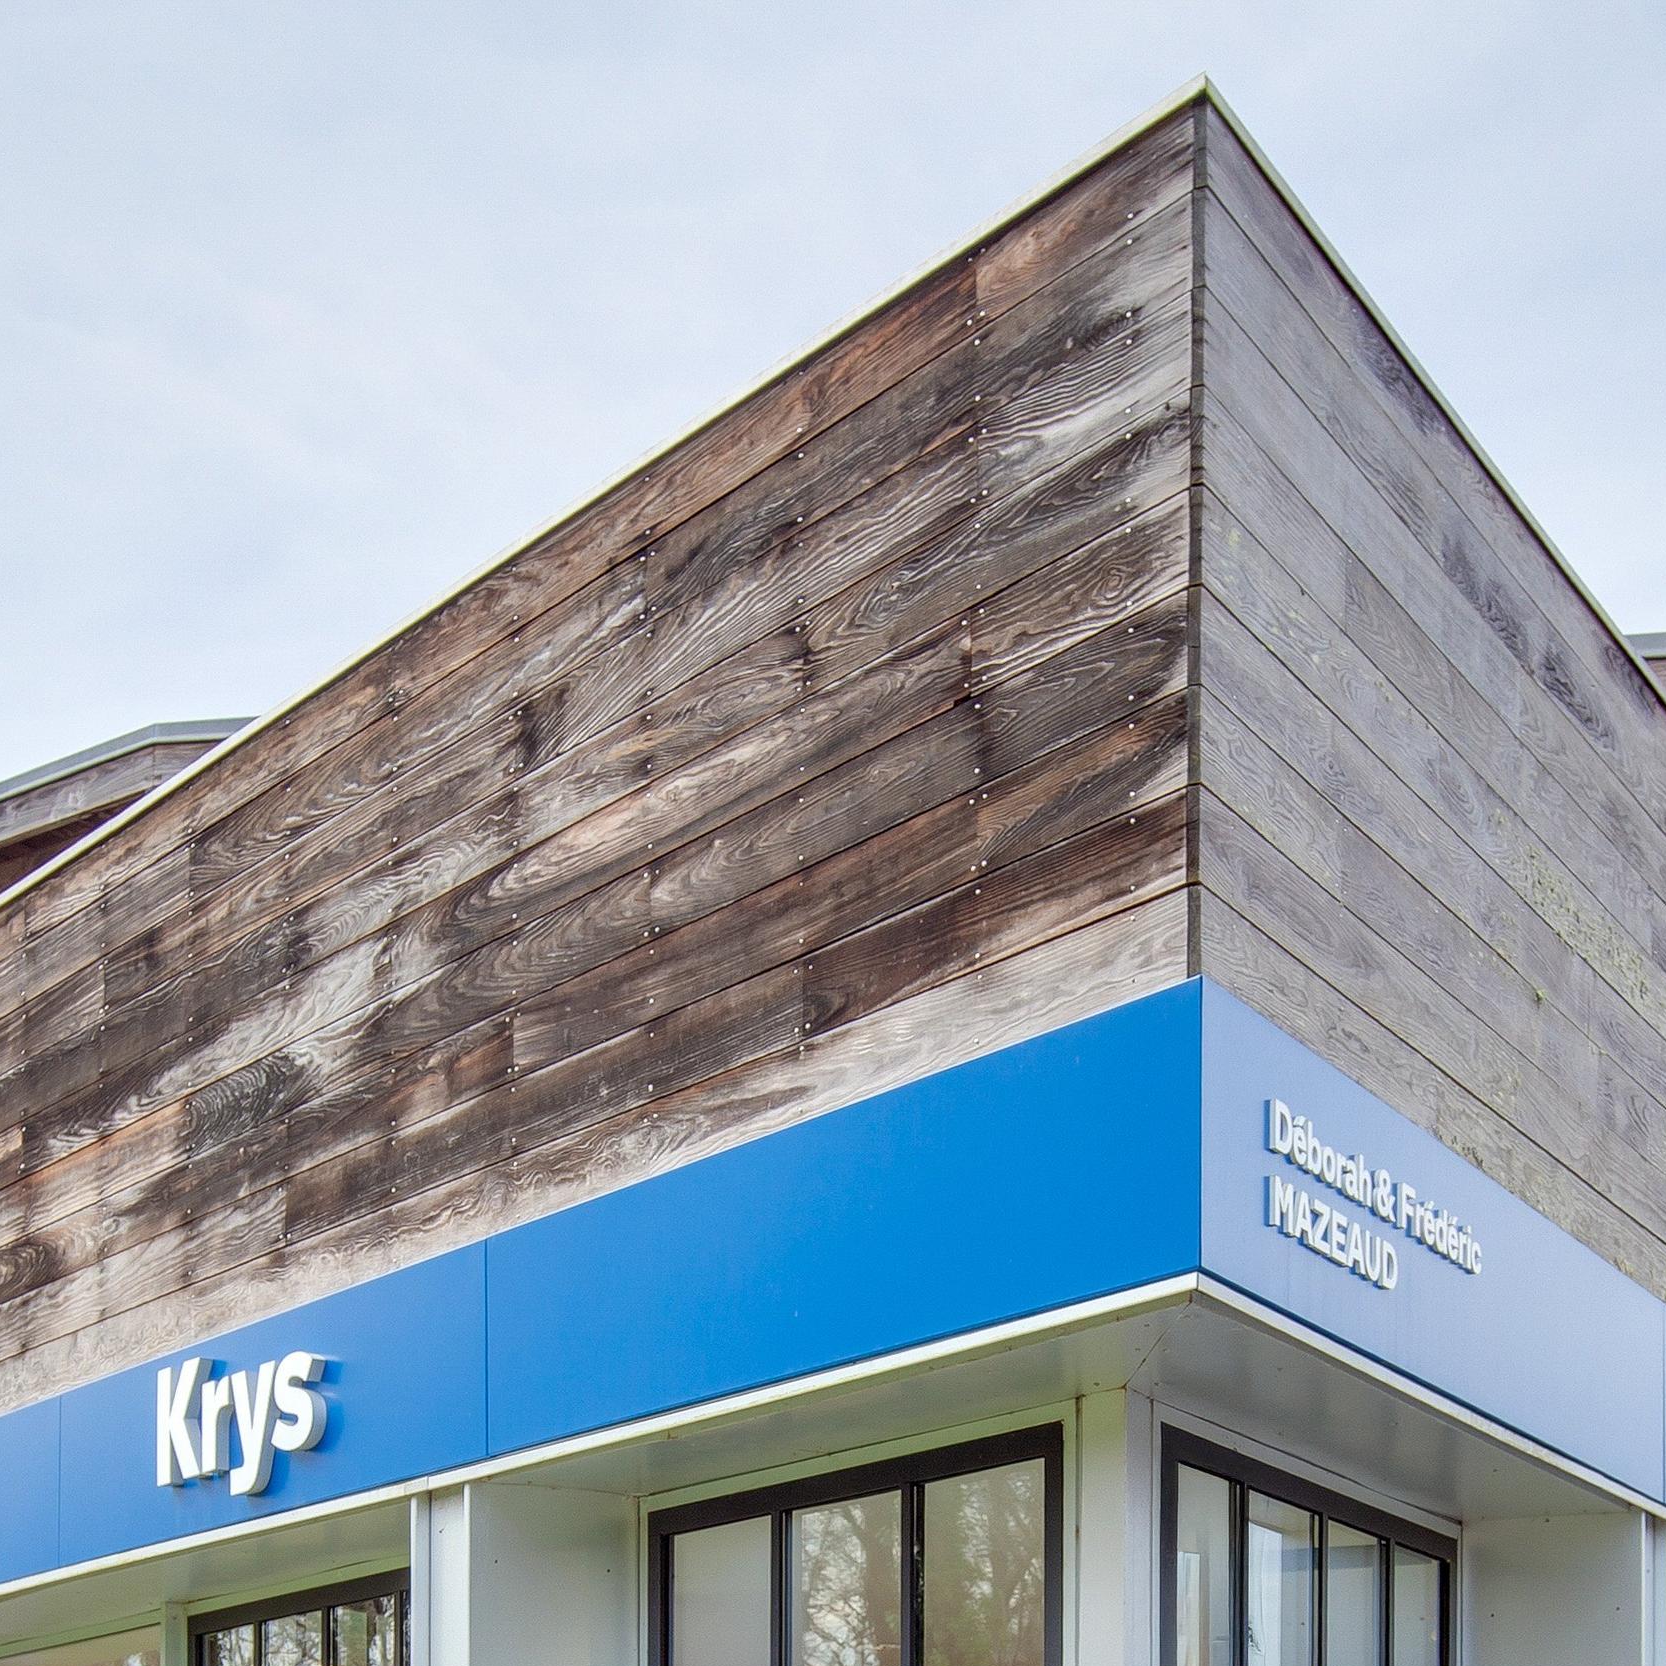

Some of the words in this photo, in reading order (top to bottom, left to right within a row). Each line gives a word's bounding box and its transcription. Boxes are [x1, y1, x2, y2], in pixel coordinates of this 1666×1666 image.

[1269, 1098, 1372, 1209] Déborah
[1373, 1168, 1396, 1223] &
[1397, 1182, 1482, 1275] Frédéric
[1269, 1174, 1399, 1290] MAZEAUD
[156, 1350, 327, 1496] Krys
